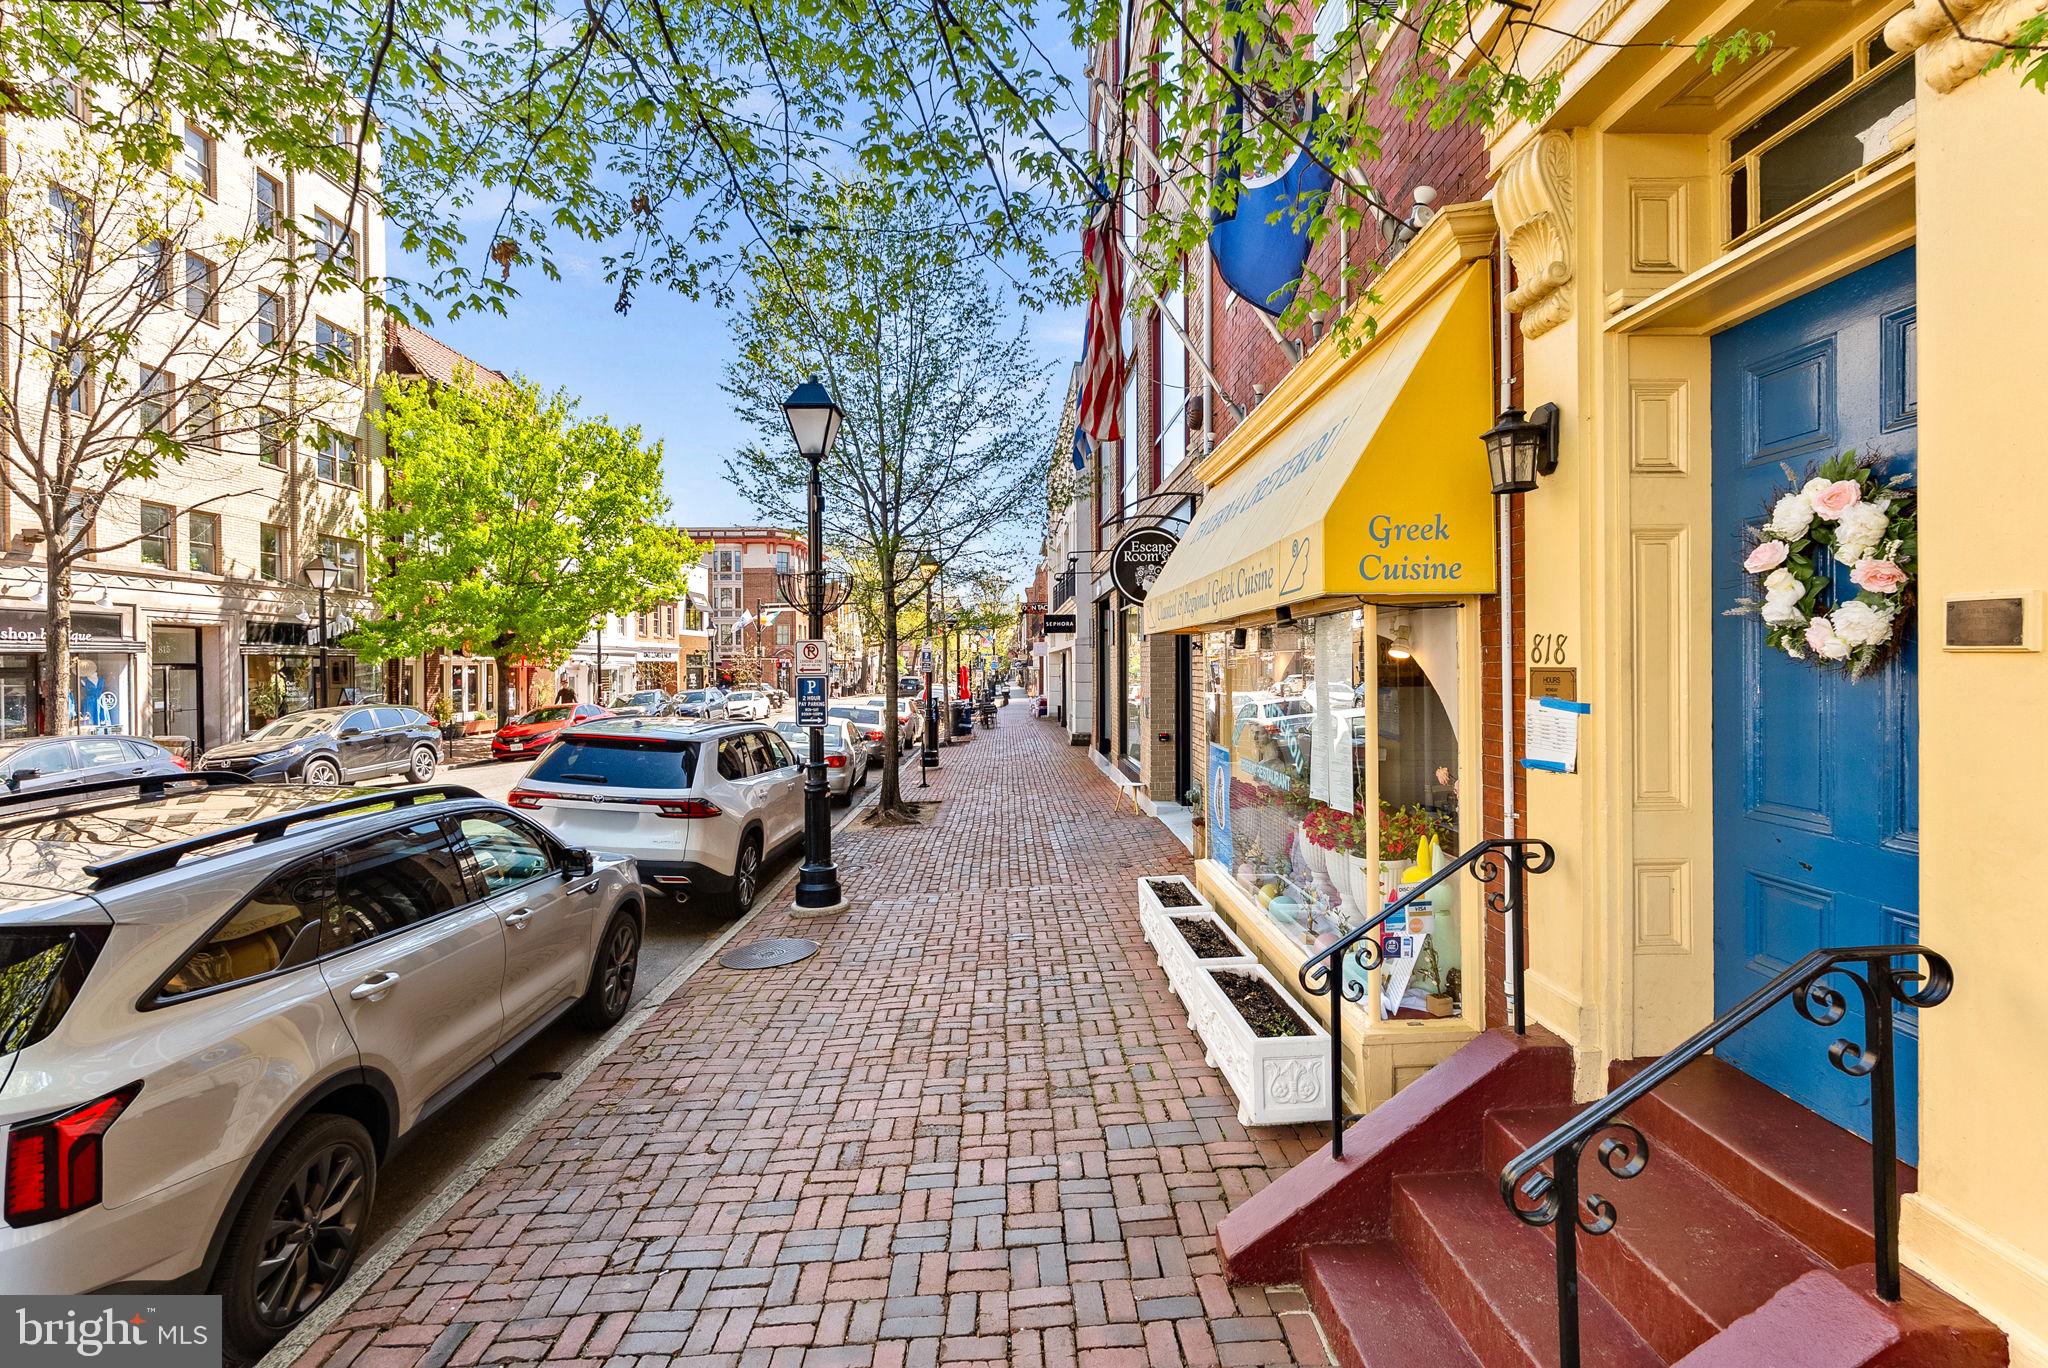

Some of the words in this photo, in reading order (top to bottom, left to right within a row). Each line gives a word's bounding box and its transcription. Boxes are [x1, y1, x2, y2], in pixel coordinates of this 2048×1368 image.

[1239, 416, 1350, 514] CRETEKOU
[1368, 513, 1450, 549] Greek
[1131, 541, 1173, 554] Escape
[1124, 551, 1160, 562] Room
[1359, 554, 1462, 581] Cuisine
[1184, 580, 1211, 618] Regional
[1212, 572, 1235, 613] Greek
[1237, 562, 1274, 599] Cuisine
[0, 627, 37, 643] shop
[40, 628, 92, 644] bique
[158, 645, 171, 654] 815
[1531, 633, 1568, 665] 818
[806, 680, 816, 694] P
[1543, 676, 1561, 684] HOURS
